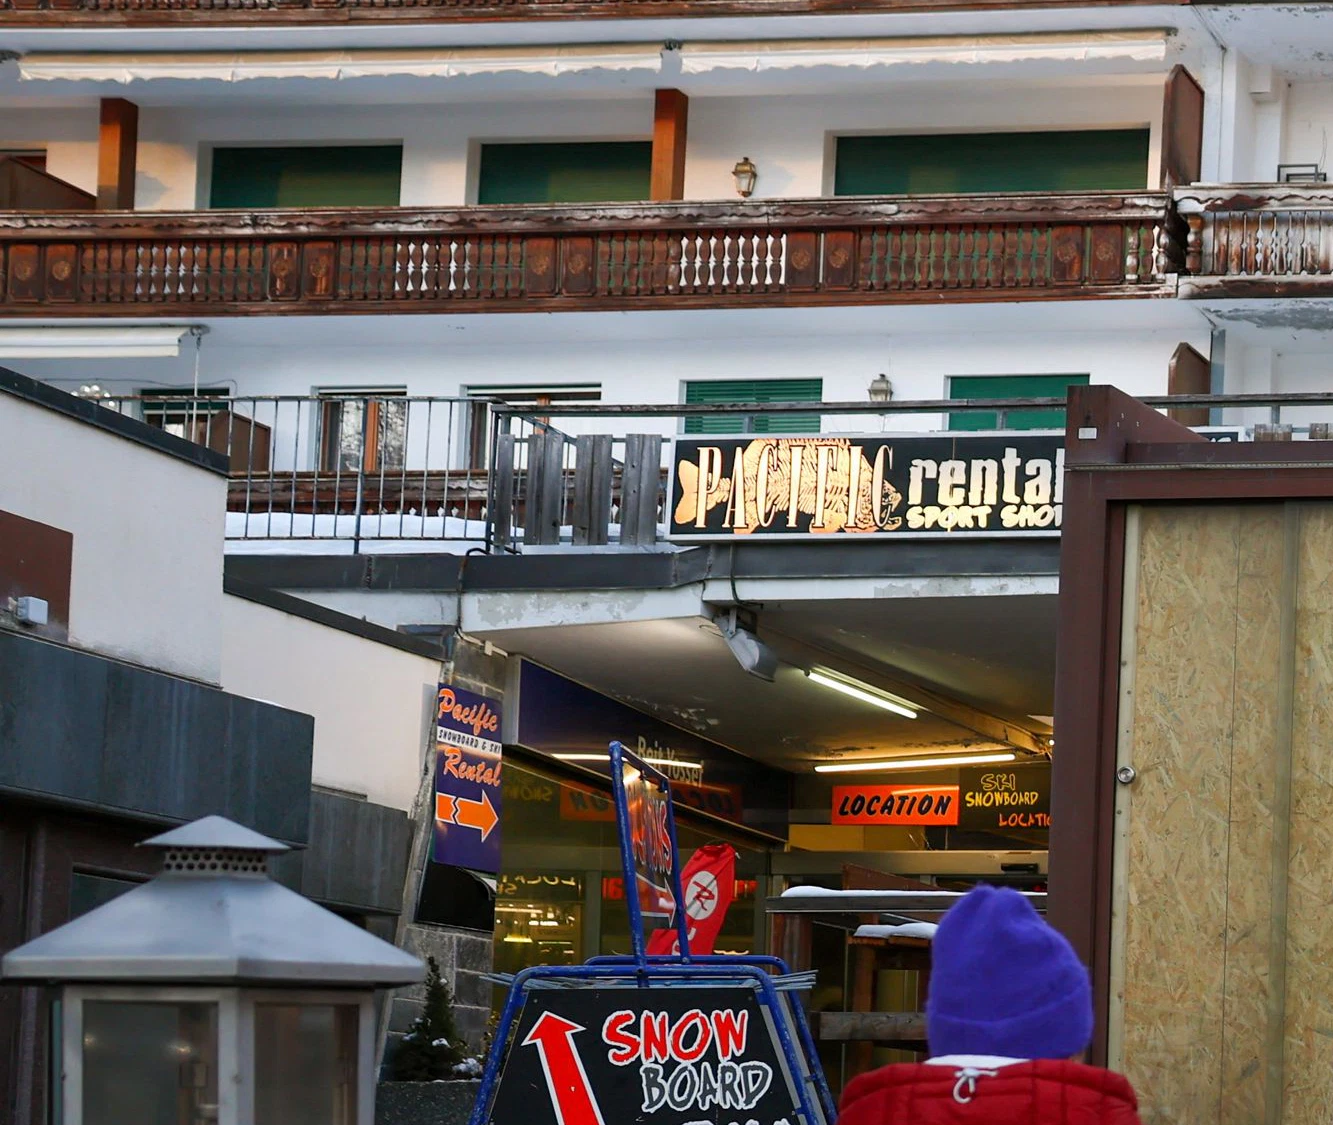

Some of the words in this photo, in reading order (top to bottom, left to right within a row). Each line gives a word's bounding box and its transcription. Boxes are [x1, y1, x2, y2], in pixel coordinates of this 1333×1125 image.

[693, 444, 894, 528] PACIFIC
[907, 447, 1064, 505] rental
[906, 504, 992, 529] SPORT
[438, 688, 498, 736] Pacific
[439, 729, 479, 749] SNOWBOARD
[443, 747, 502, 788] Rental
[980, 773, 1016, 791] SKI
[838, 794, 952, 816] LOCATION
[965, 791, 1039, 808] SNOWBOARD
[602, 1007, 749, 1067] SNOW
[639, 1060, 774, 1113] BOARD
